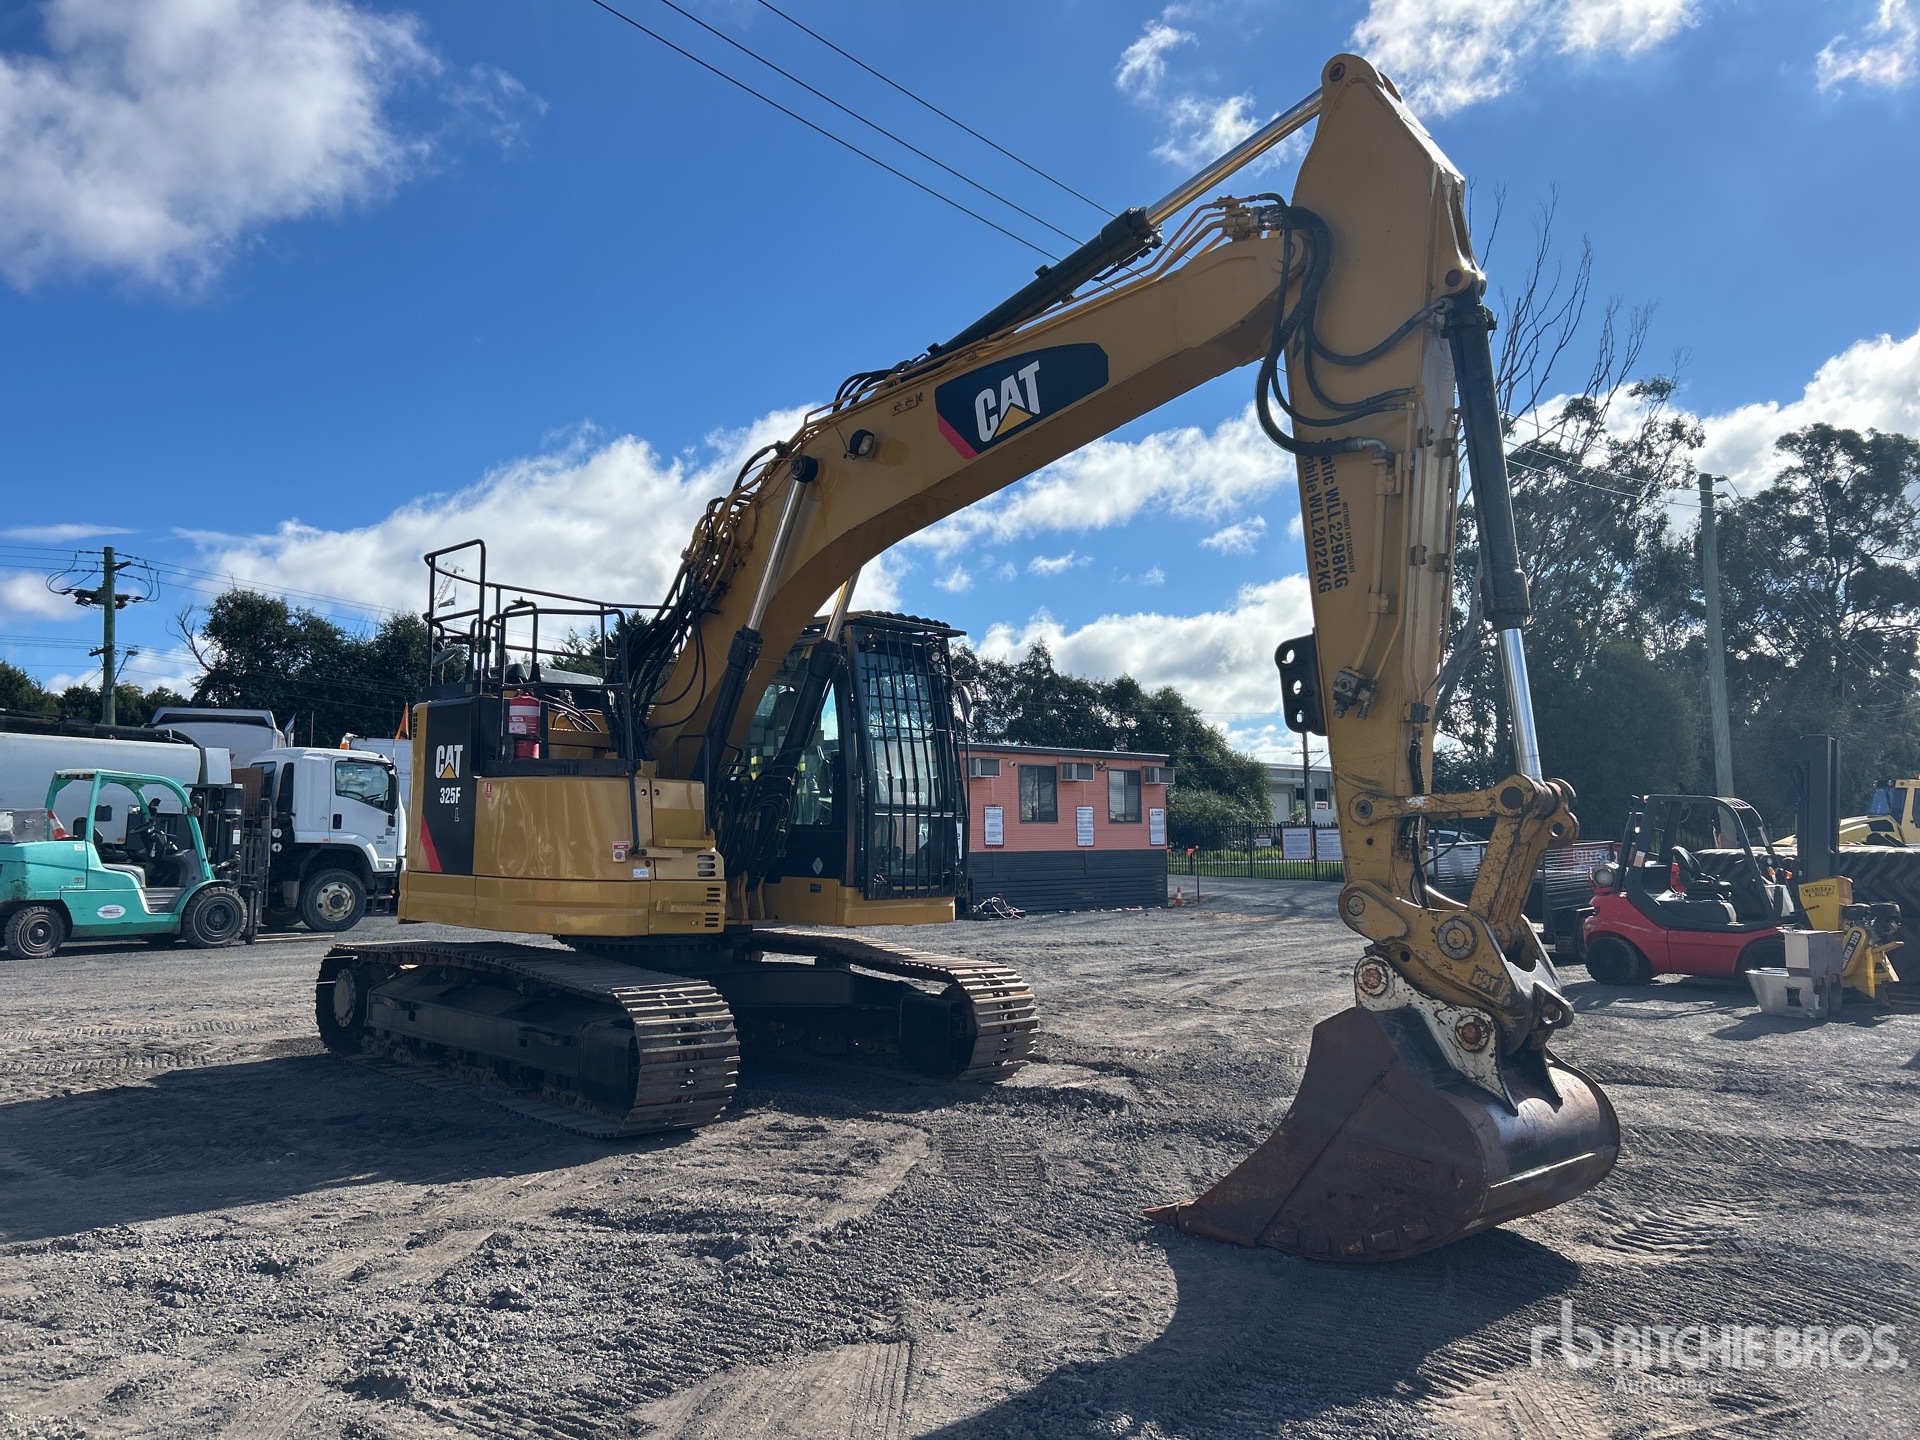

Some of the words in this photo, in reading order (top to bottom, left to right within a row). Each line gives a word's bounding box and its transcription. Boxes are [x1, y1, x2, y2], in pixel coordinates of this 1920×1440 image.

[975, 360, 1041, 443] CAT
[1303, 454, 1319, 493] obile
[1320, 437, 1336, 486] atic
[1308, 492, 1325, 527] WLL
[1325, 486, 1341, 522] WLL
[1342, 501, 1351, 529] WITHOUT
[1346, 532, 1356, 573] ATTACHMENT
[435, 744, 464, 779] CAT
[439, 787, 462, 804] 325F
[454, 807, 460, 822] L
